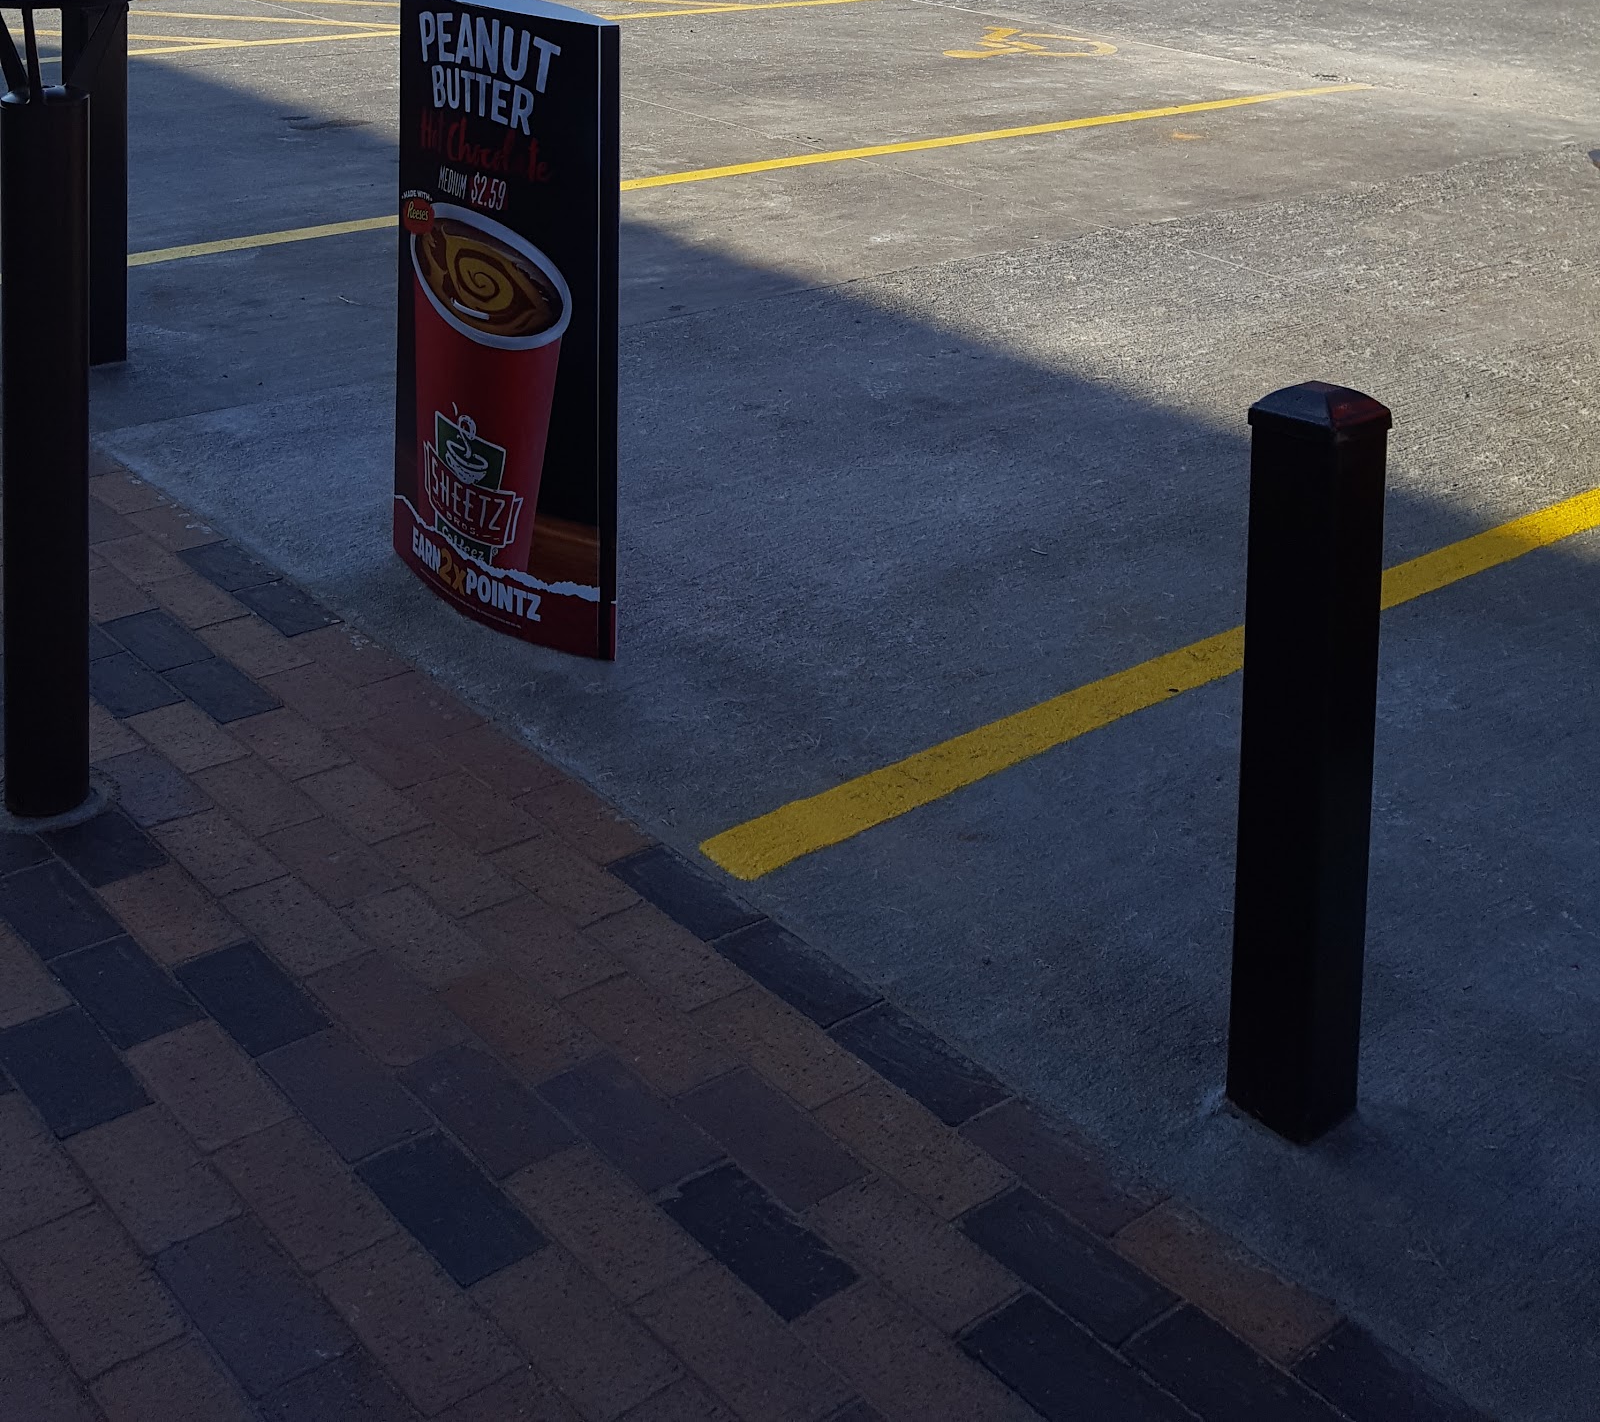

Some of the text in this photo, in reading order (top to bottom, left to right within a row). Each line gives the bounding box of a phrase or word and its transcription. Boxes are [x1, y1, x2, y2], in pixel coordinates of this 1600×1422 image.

[419, 10, 561, 94] PEANUT
[431, 64, 534, 136] BUTTER
[419, 107, 444, 153] Hot
[403, 190, 431, 201] MADE WITH
[438, 165, 507, 211] MEDIUM $2.59
[431, 461, 507, 531] SHEETZ
[446, 512, 480, 538] BROS.
[412, 525, 441, 575] EARN
[466, 567, 542, 623] POINTZ
